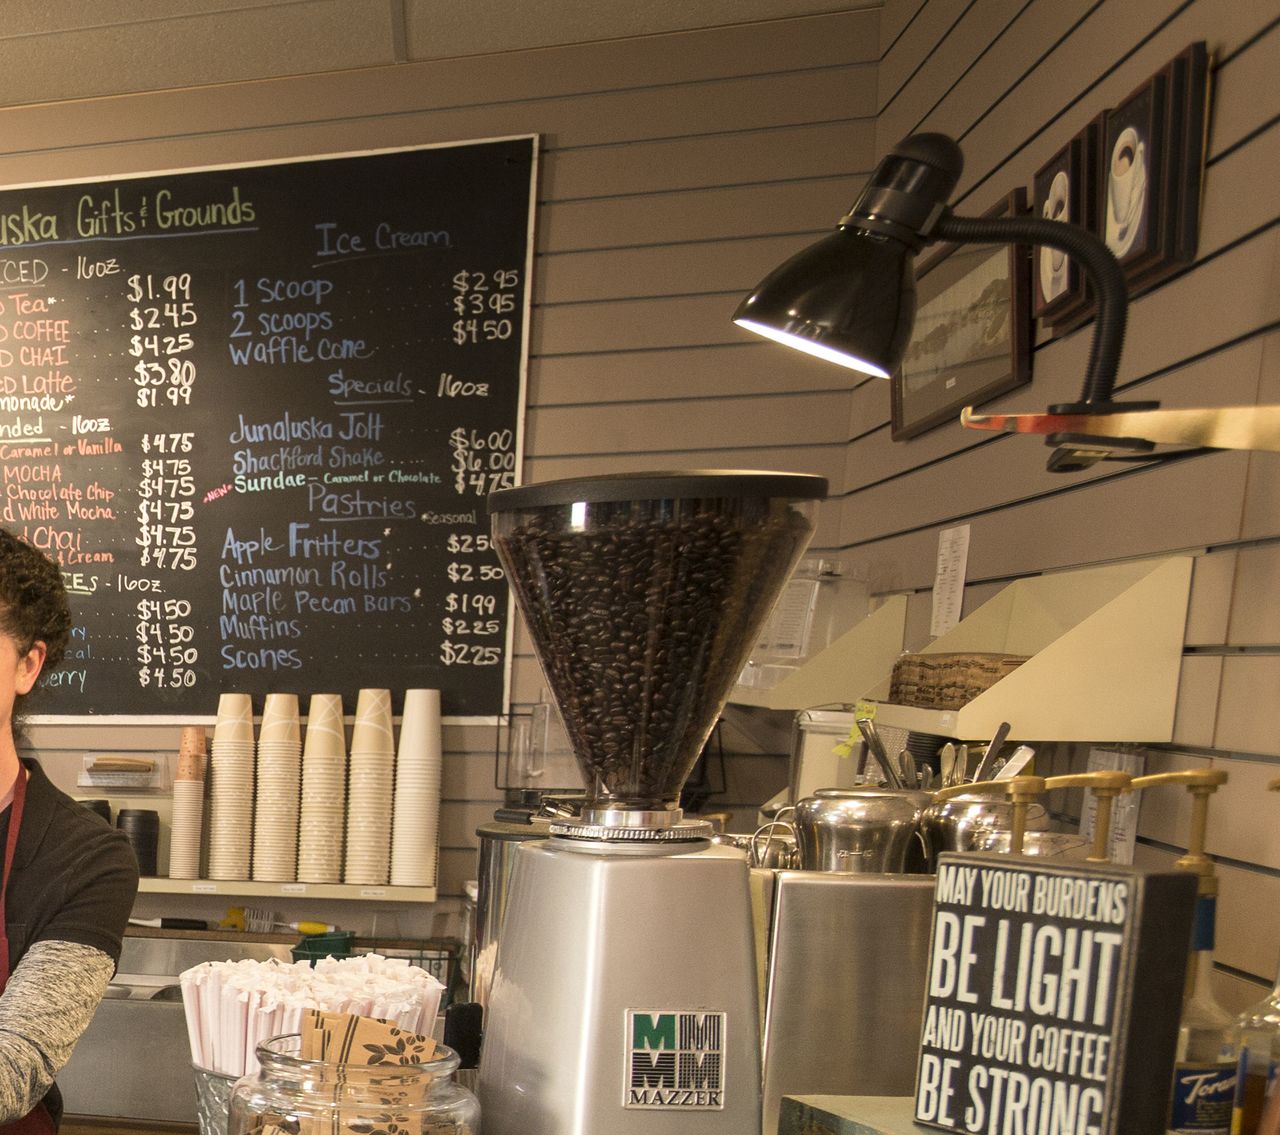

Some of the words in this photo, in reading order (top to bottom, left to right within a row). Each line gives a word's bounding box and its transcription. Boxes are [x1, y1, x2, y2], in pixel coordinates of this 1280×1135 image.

[77, 188, 136, 238] Gifts
[156, 186, 256, 229] Grounds
[315, 223, 366, 257] Ice
[375, 222, 452, 249] Cream
[127, 273, 191, 302] $1.99
[130, 303, 197, 331] $2.45
[13, 319, 70, 343] COFFEE
[19, 345, 69, 367] CHAI
[129, 334, 194, 356] $4.25
[134, 359, 196, 387] $3.80
[328, 368, 412, 398] Specials
[136, 387, 192, 409] $1.99
[230, 411, 332, 444] Junaluska
[0, 445, 58, 460] Caramel
[77, 438, 123, 455] Vanilla
[141, 432, 195, 453] $4.75
[329, 446, 384, 467] Shake
[3, 465, 62, 483] MOCHA
[234, 472, 306, 493] Sundae
[323, 470, 369, 484] Caramel
[373, 473, 385, 483] or
[388, 469, 442, 484] Chocolate
[6, 482, 82, 501] Chocolate
[86, 482, 115, 503] Chip
[307, 482, 416, 519] Pastries
[18, 502, 60, 521] White
[66, 501, 115, 521] Mocha
[33, 527, 81, 550] Chai
[221, 527, 285, 564] Apple
[67, 552, 115, 565] Cream
[220, 564, 321, 588] Cinnamon
[137, 599, 191, 620] $4.50
[222, 587, 287, 615] Maple
[295, 591, 357, 614] Pecan
[220, 615, 301, 640] Muffins
[221, 644, 302, 671] Scones
[936, 865, 978, 907] MAY
[981, 869, 1031, 913] YOUR
[1032, 875, 1128, 925] BURDENS
[929, 911, 986, 1004] BE
[990, 919, 1123, 1027] LIGHT
[922, 1005, 966, 1052] AND
[971, 1012, 1027, 1065] YOUR
[1028, 1024, 1111, 1082] COFFEE
[629, 1089, 722, 1106] MAZZER
[916, 1053, 961, 1127] BE
